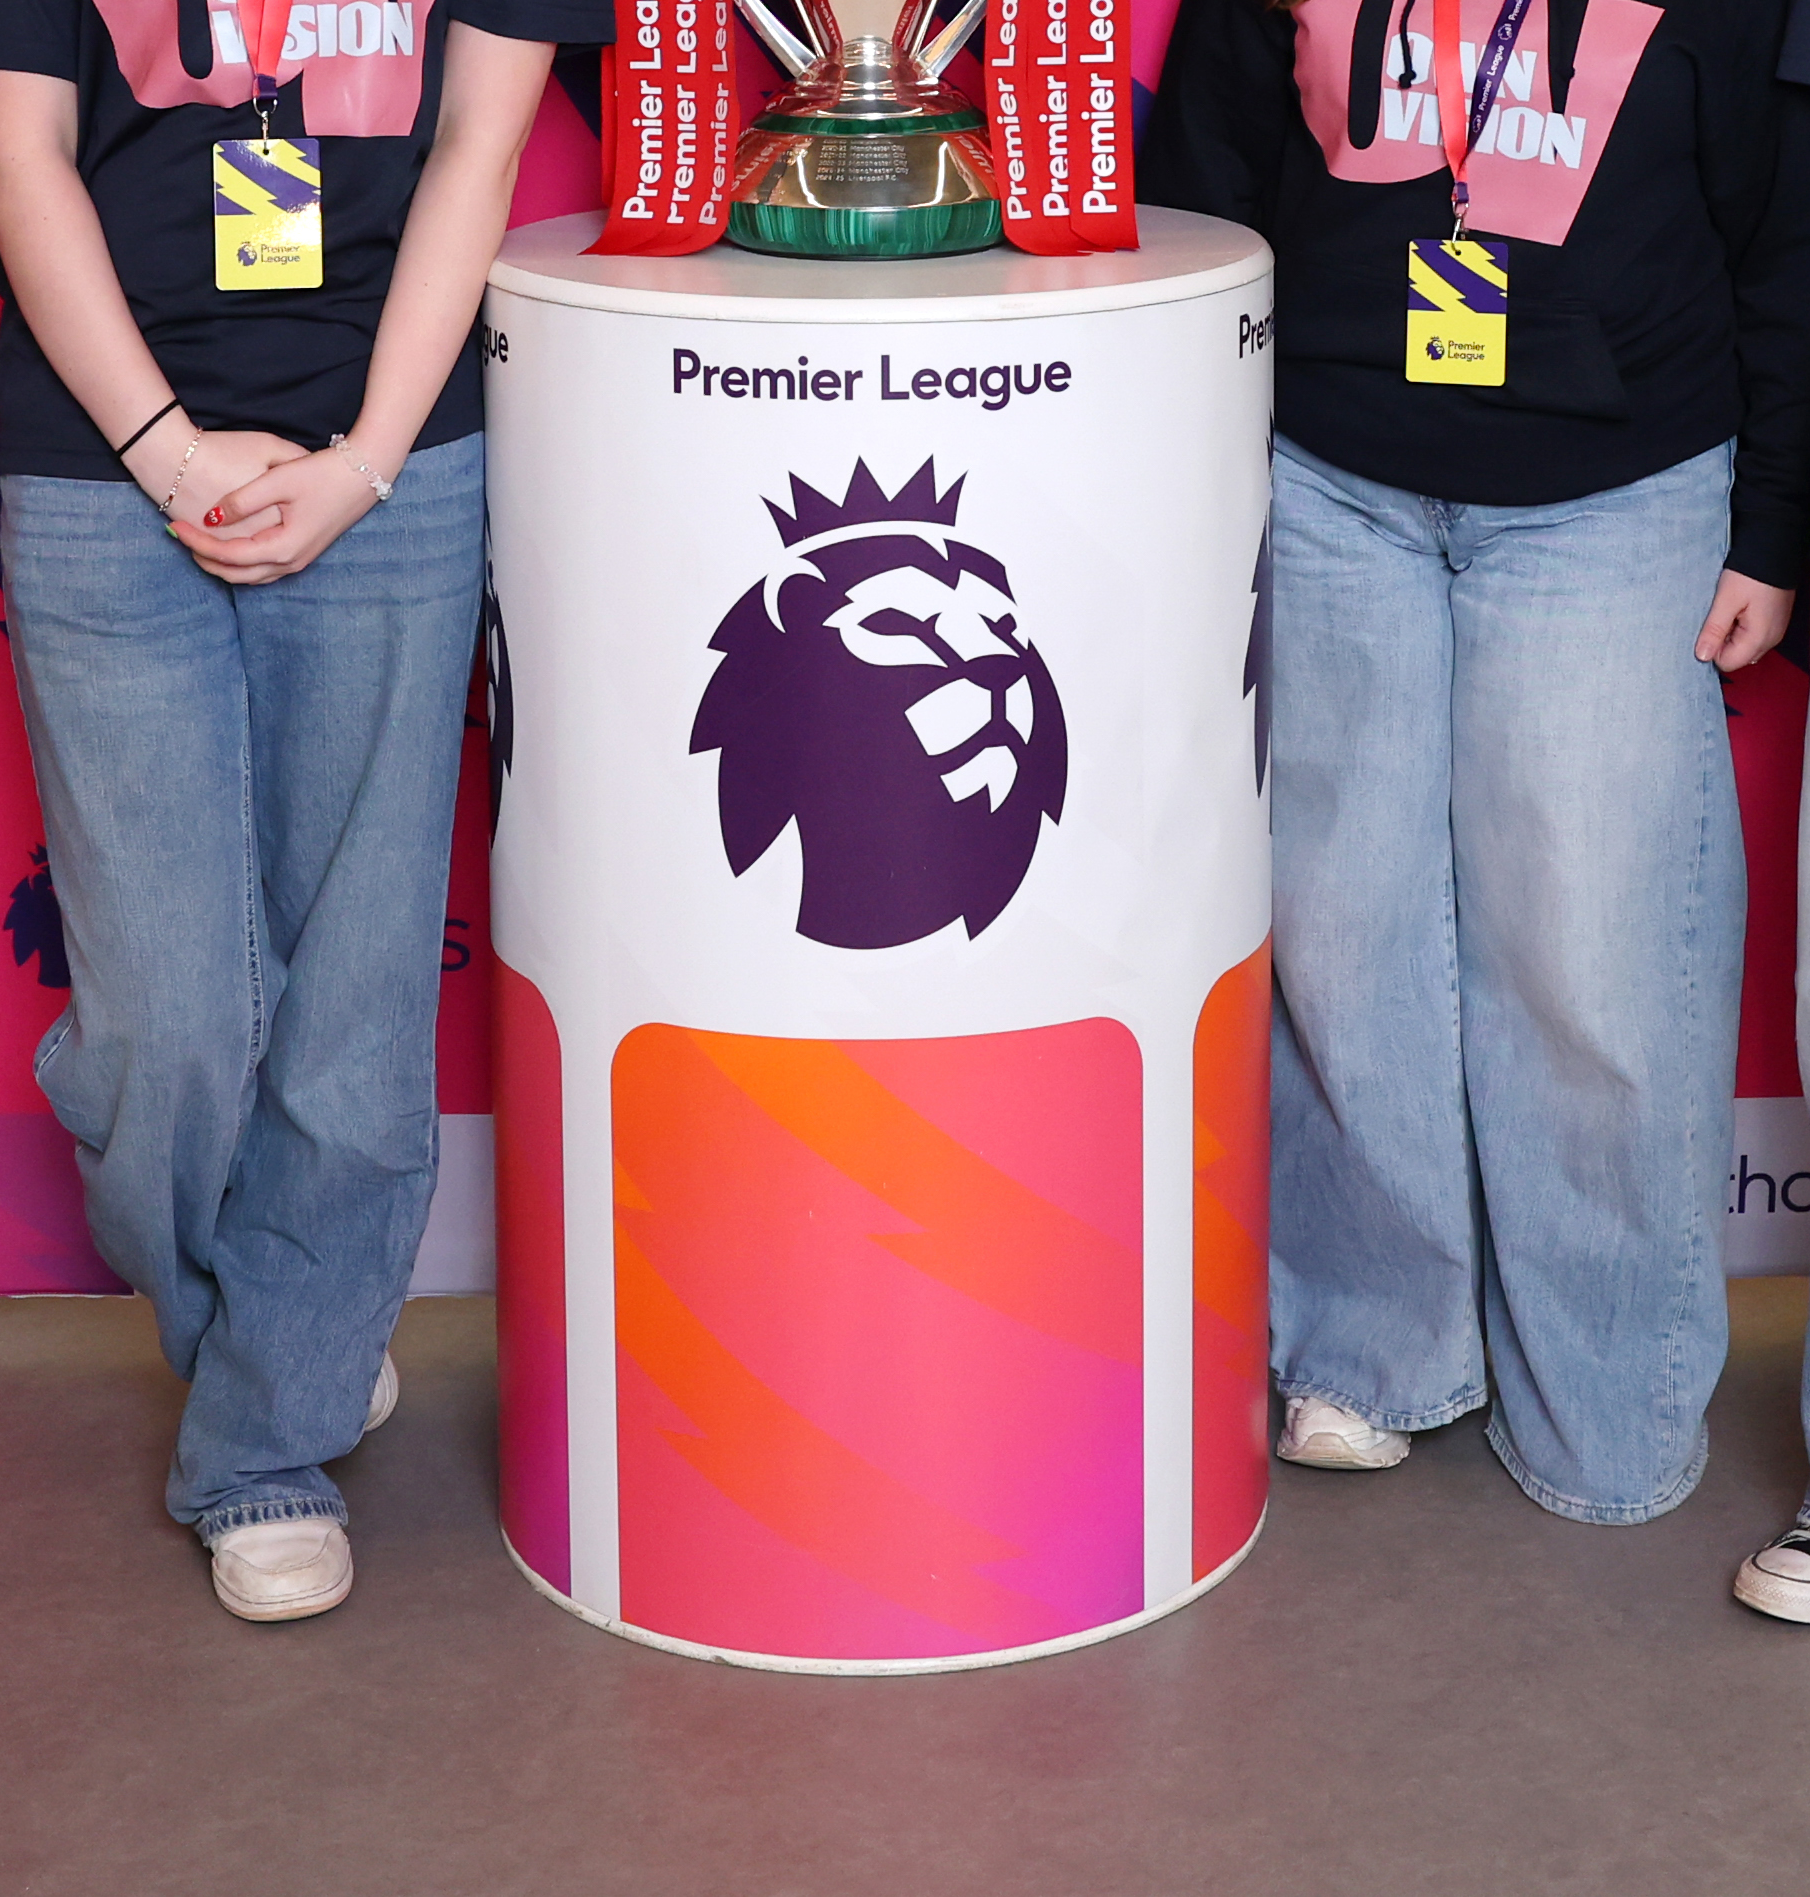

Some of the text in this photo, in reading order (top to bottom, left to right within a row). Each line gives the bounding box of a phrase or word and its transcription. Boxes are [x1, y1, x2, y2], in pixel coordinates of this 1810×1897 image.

[211, 0, 414, 64] VSION
[622, 80, 664, 219] Premier
[699, 82, 730, 225] Premier
[997, 78, 1032, 220] Premier
[1039, 75, 1069, 217] Premier
[1082, 73, 1118, 214] Premier
[1383, 87, 1587, 170] VIION
[261, 254, 300, 265] League
[672, 347, 1072, 411] Premier League
[1448, 340, 1485, 351] Premier
[1448, 351, 1485, 362] League
